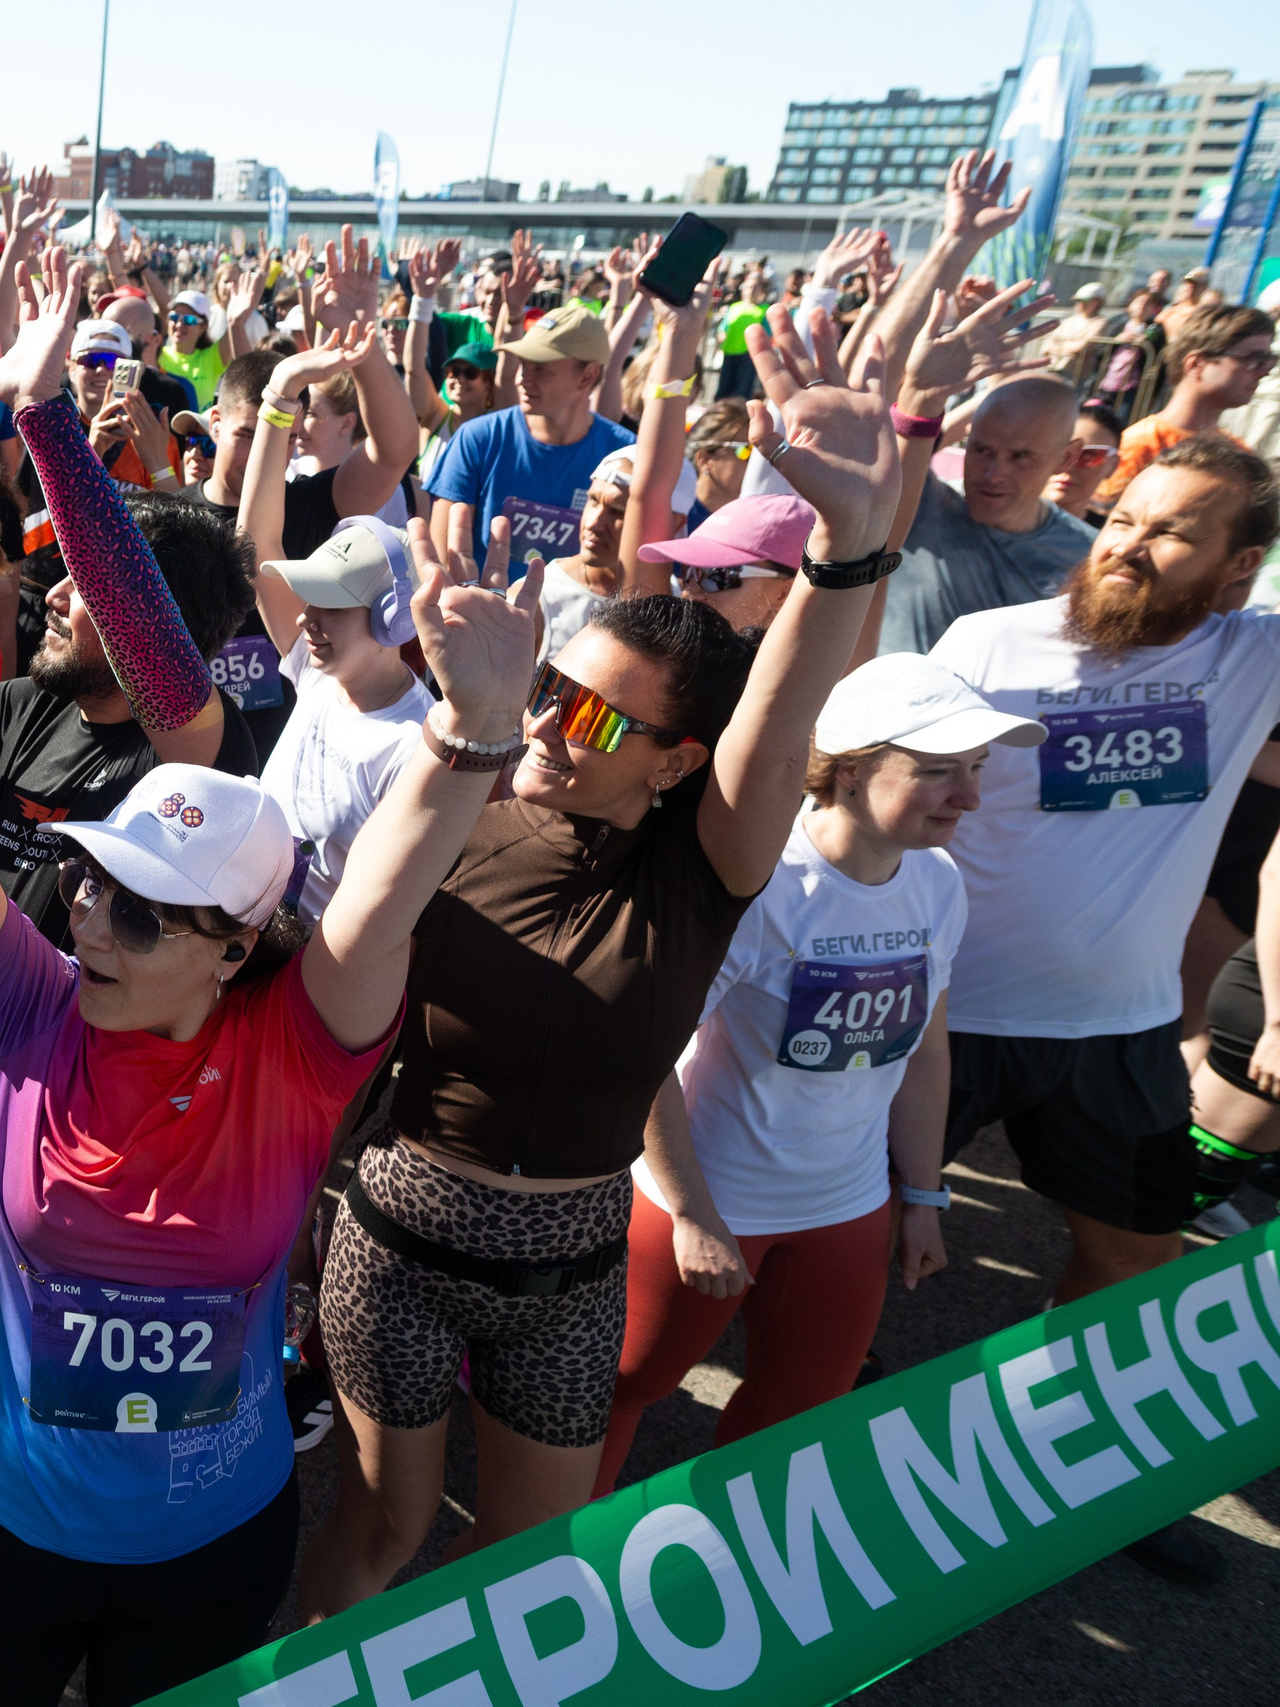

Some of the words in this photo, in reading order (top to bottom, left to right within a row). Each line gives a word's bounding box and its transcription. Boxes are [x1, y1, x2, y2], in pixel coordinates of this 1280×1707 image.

[512, 512, 575, 546] 7347
[220, 681, 251, 694] ДРЕЙ
[1064, 726, 1184, 772] 3483
[1086, 765, 1163, 785] АЛЕКСЕЙ
[1, 819, 19, 834] RUN
[812, 934, 871, 957] БЕГИ,
[813, 984, 913, 1030] 4091
[792, 1039, 828, 1056] 0237
[843, 1029, 885, 1045] ОЛЬГА
[50, 1282, 61, 1293] 10
[63, 1311, 213, 1374] 7032
[222, 1406, 261, 1449] ГОРОД
[225, 1419, 264, 1466] БЕЖИТ
